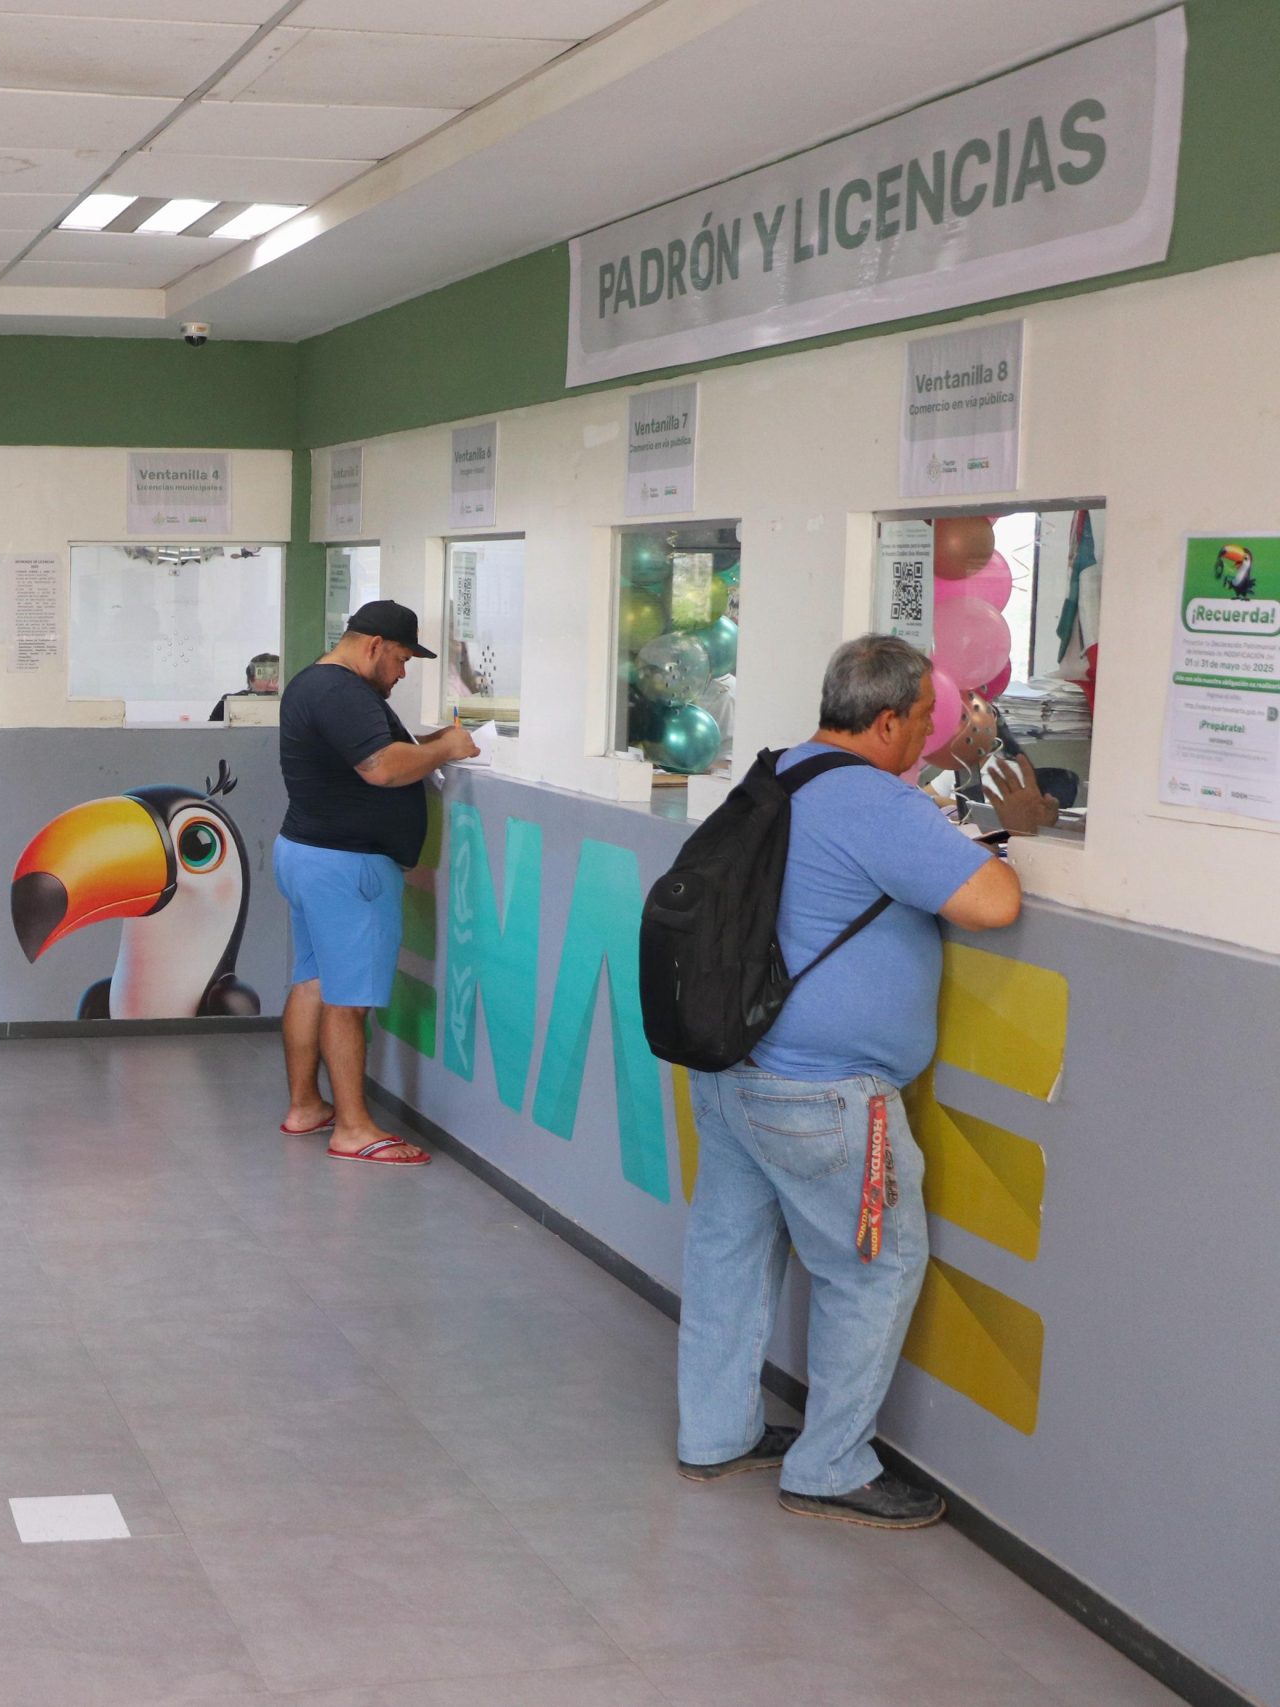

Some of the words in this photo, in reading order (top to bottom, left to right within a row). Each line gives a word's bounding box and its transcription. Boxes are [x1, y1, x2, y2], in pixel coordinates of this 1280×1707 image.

[598, 210, 742, 319] PADRÓN
[754, 206, 786, 273] Y
[793, 98, 1108, 264] LICENCIAS
[915, 364, 993, 394] Ventanilla
[997, 360, 1009, 381] 8
[909, 400, 950, 415] Comercio
[952, 400, 963, 411] en
[634, 416, 680, 436] Ventanilla
[682, 413, 689, 428] 7
[139, 469, 209, 480] Ventanilla
[211, 470, 219, 480] 4
[175, 484, 223, 492] municipales
[1191, 605, 1275, 624] ¡Recuerda!
[1185, 658, 1193, 667] 01
[1201, 659, 1208, 668] 31
[1219, 661, 1240, 671] mayo
[1253, 663, 1274, 673] 2025
[871, 1118, 884, 1182] HONDA
